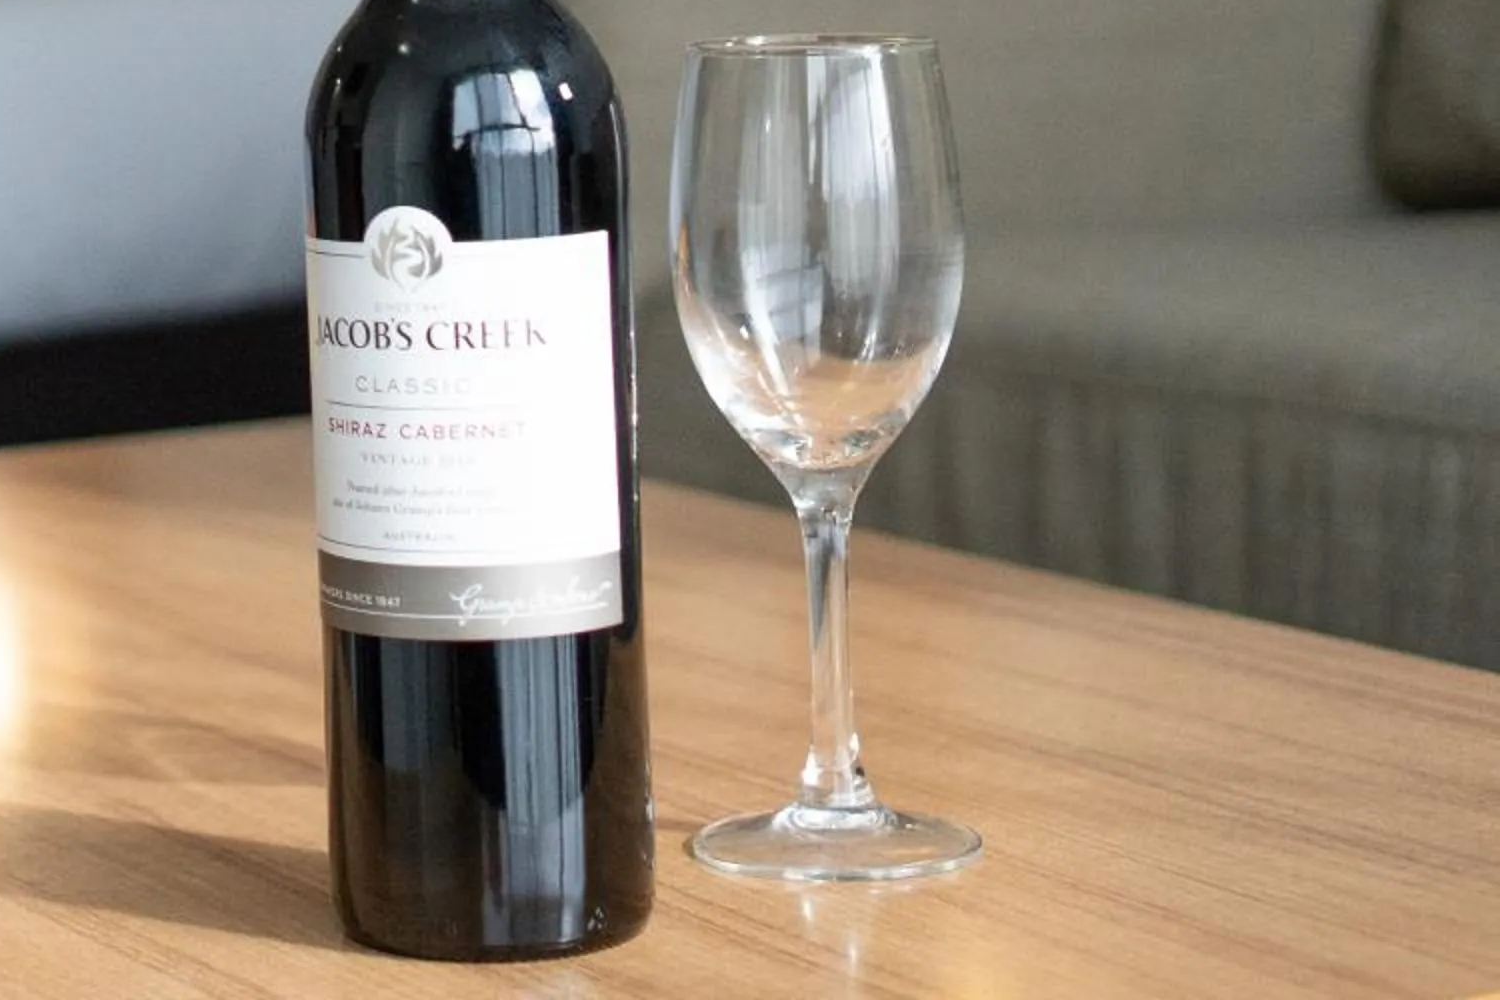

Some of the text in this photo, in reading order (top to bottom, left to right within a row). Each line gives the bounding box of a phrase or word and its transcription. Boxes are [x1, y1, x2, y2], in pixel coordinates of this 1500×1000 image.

[316, 316, 546, 351] JACOB'S CREEK
[355, 375, 471, 394] CLASSIC
[328, 416, 527, 441] SHIRAZ CABERNET
